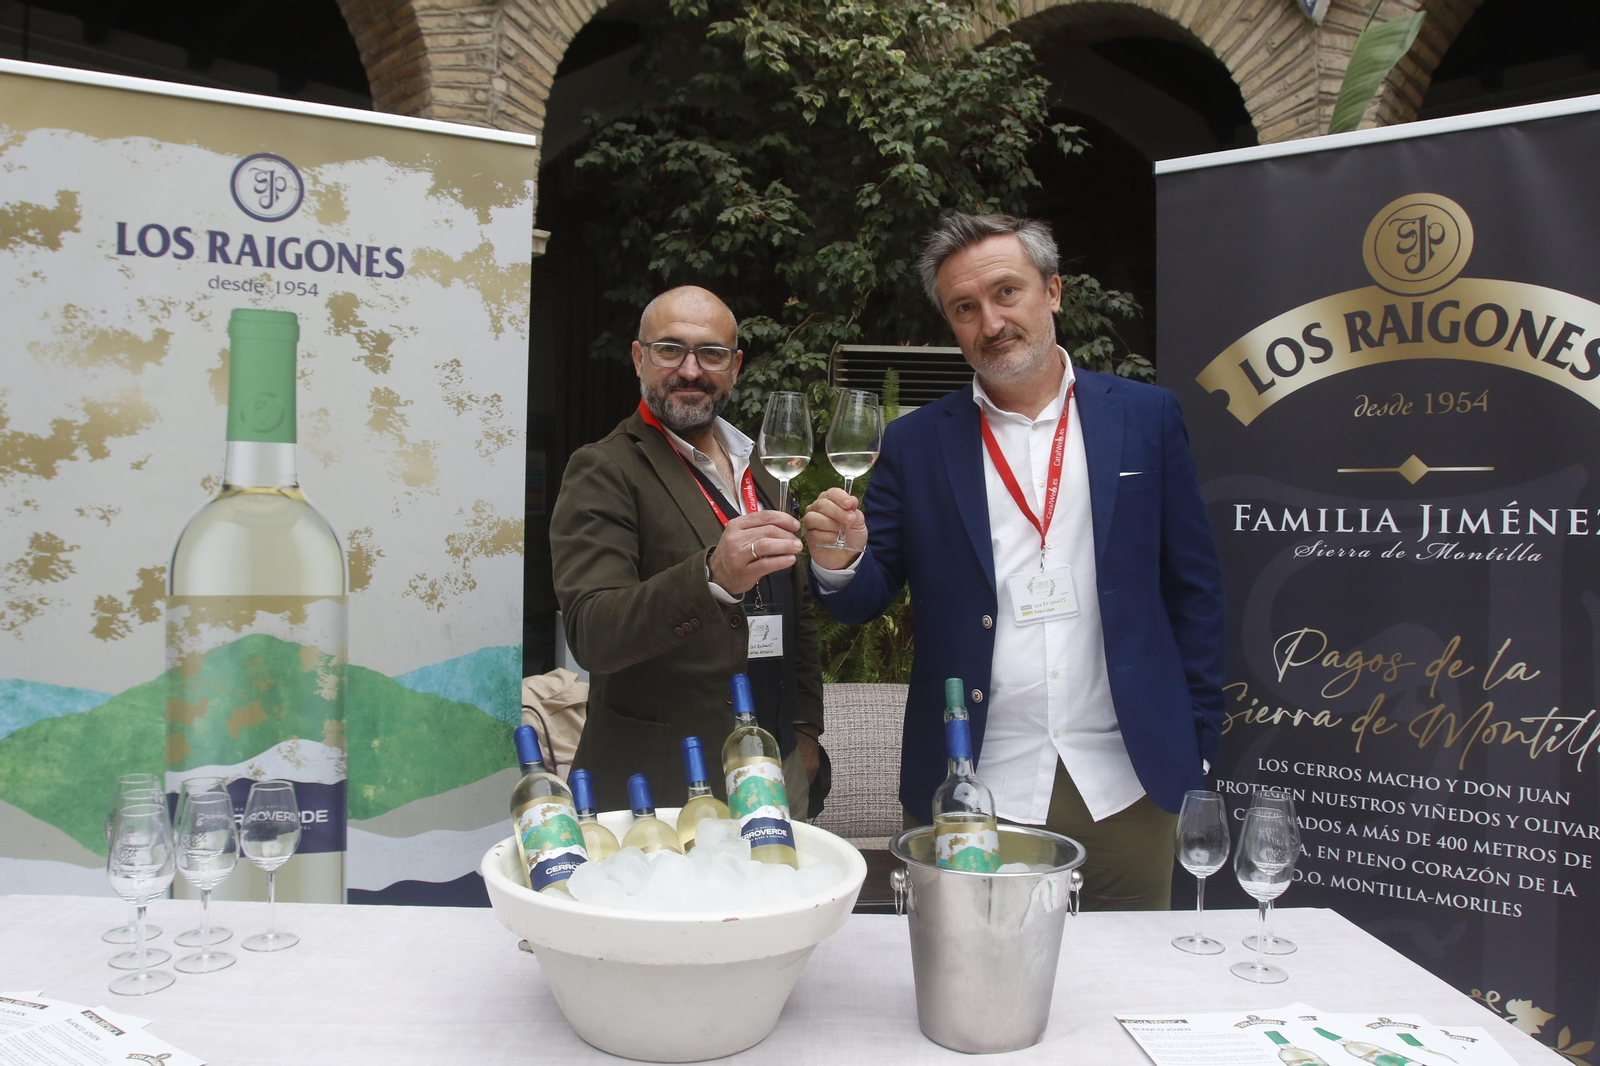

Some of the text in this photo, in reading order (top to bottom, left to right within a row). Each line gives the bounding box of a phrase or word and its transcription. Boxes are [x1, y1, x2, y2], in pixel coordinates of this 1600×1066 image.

[115, 221, 405, 279] LOS RAIGONES
[208, 274, 319, 297] desde 1954
[1238, 299, 1600, 396] LOS RAIGONES
[1354, 389, 1490, 417] desde 1954
[1233, 500, 1600, 542] FAMILIA JIMÉNE
[1293, 540, 1543, 562] Sierra de Montilla
[1273, 627, 1541, 699] Pagos de la
[1351, 692, 1398, 753] de
[1407, 700, 1600, 773] Montill
[1258, 757, 1571, 807] LOS CERROS MACHO Y DON JUAN
[1311, 790, 1406, 815] NUESTROS
[1410, 802, 1500, 827] VIÑEDOS
[1506, 814, 1520, 829] Y
[1346, 822, 1358, 837] A
[1362, 824, 1400, 843] MÁS
[1406, 830, 1431, 847] DE
[1436, 836, 1468, 851] 400
[1473, 840, 1557, 864] METROS
[1563, 851, 1592, 869] DE
[1317, 846, 1340, 861] EN
[1346, 849, 1407, 871] PLENO
[1411, 858, 1511, 887] CORAZÓN
[1518, 874, 1545, 892] DE
[1552, 879, 1578, 898] LA
[1330, 875, 1523, 918] MONTILLA-MORILES
